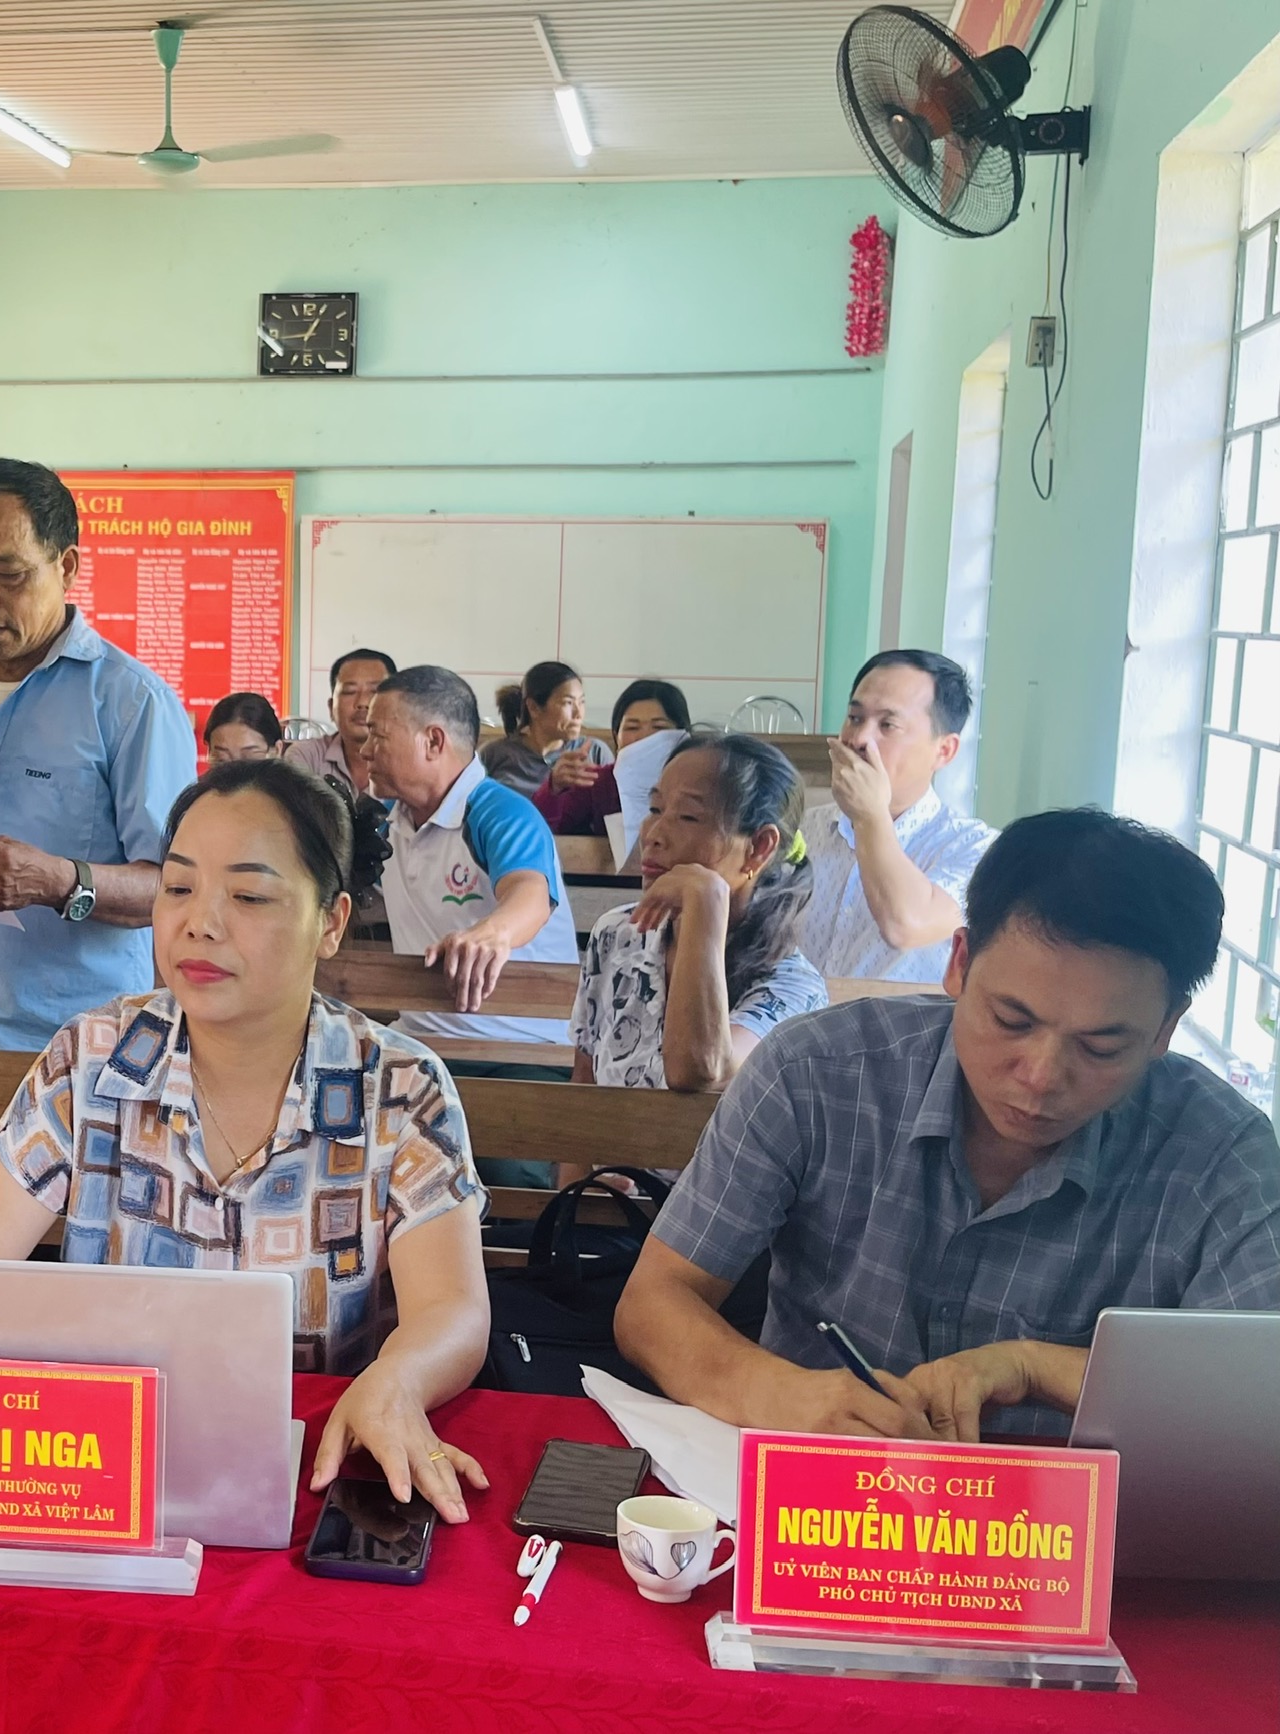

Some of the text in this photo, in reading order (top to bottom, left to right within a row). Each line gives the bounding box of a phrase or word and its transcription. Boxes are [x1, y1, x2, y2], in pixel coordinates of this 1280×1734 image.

[88, 517, 143, 536] TRÁCH
[148, 518, 172, 539] HỘ
[176, 520, 206, 536] GIA
[209, 518, 252, 536] ĐÌNH
[3, 1390, 40, 1410] CHÍ
[25, 1430, 102, 1470] NGA
[61, 1483, 81, 1500] VỤ
[855, 1465, 996, 1498] ĐỒNG CHÍ
[22, 1501, 43, 1517] XÃ
[45, 1502, 81, 1523] VIỆT
[83, 1504, 115, 1521] LÂM
[777, 1497, 1074, 1561] NGUYỄN VĂN ĐỒNG
[800, 1560, 842, 1580] VIÊN
[846, 1567, 882, 1582] BAN
[886, 1566, 935, 1586] CHẤP
[938, 1570, 988, 1589] HÀNH
[992, 1572, 1041, 1591] ĐẢNG
[1045, 1575, 1071, 1597] BỘ
[818, 1583, 1023, 1612] PHÓ CHỦ TỊCH UBND XÃ
